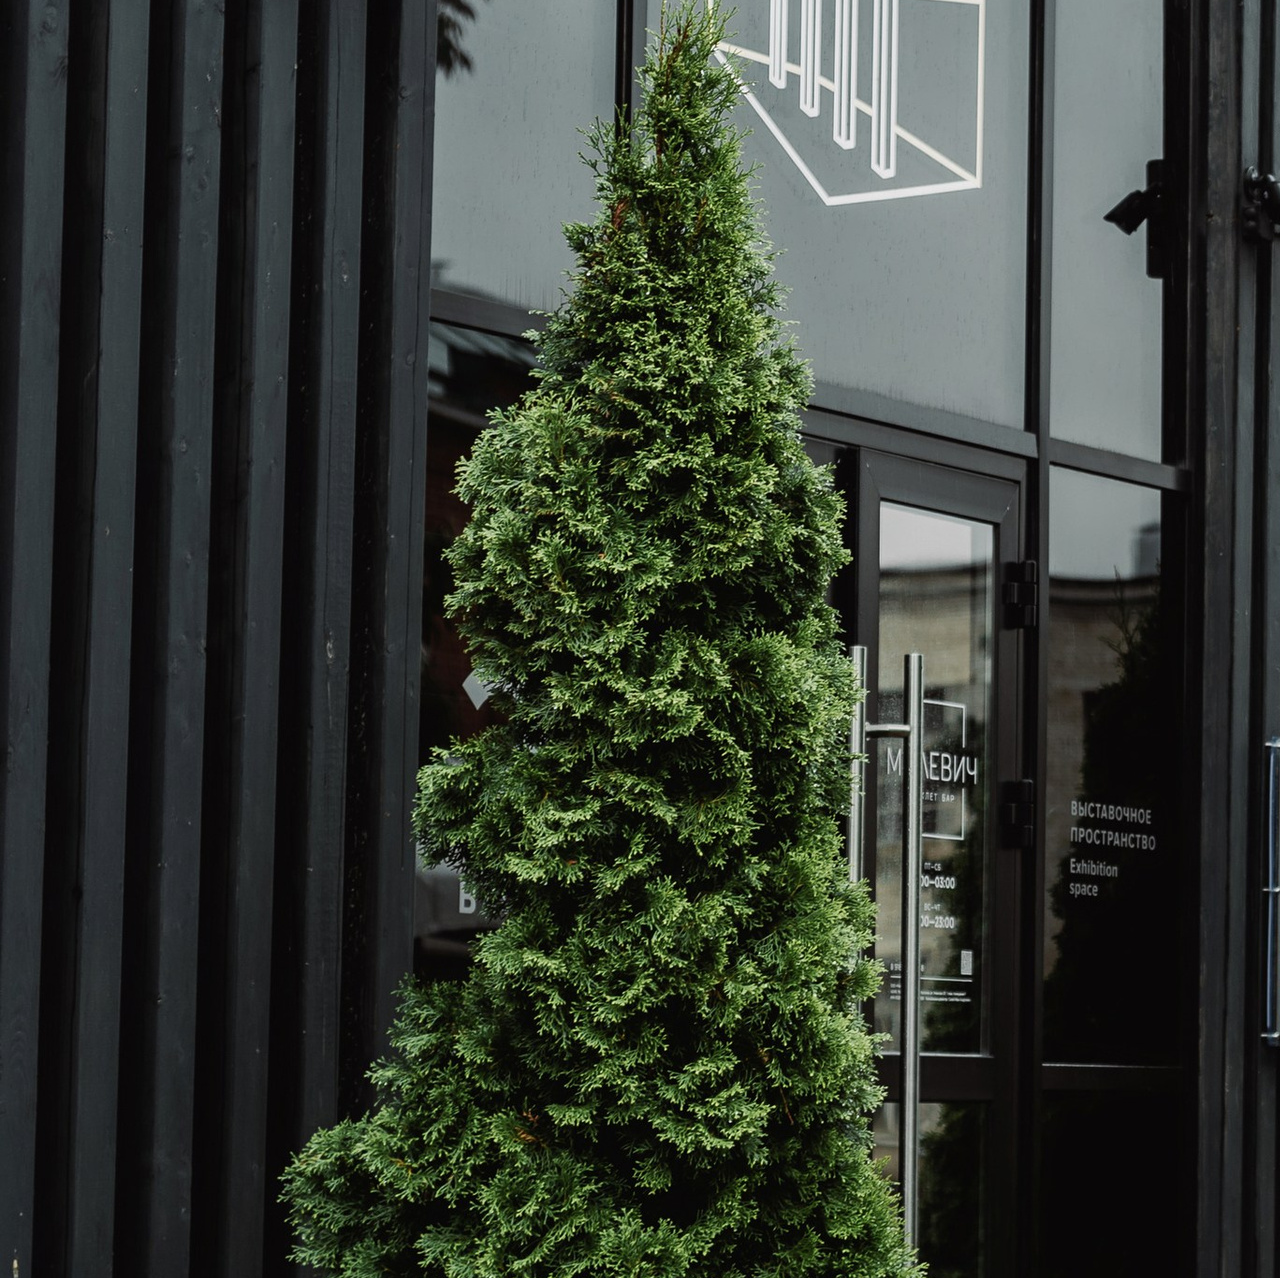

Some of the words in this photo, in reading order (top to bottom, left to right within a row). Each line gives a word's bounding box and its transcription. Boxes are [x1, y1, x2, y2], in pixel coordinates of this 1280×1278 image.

[1071, 800, 1152, 824] ВЫСТАВОЧНОЕ
[1070, 826, 1156, 850] ПРОСТРАНСТВО
[1070, 858, 1118, 877] Exhibition
[1069, 882, 1098, 898] space
